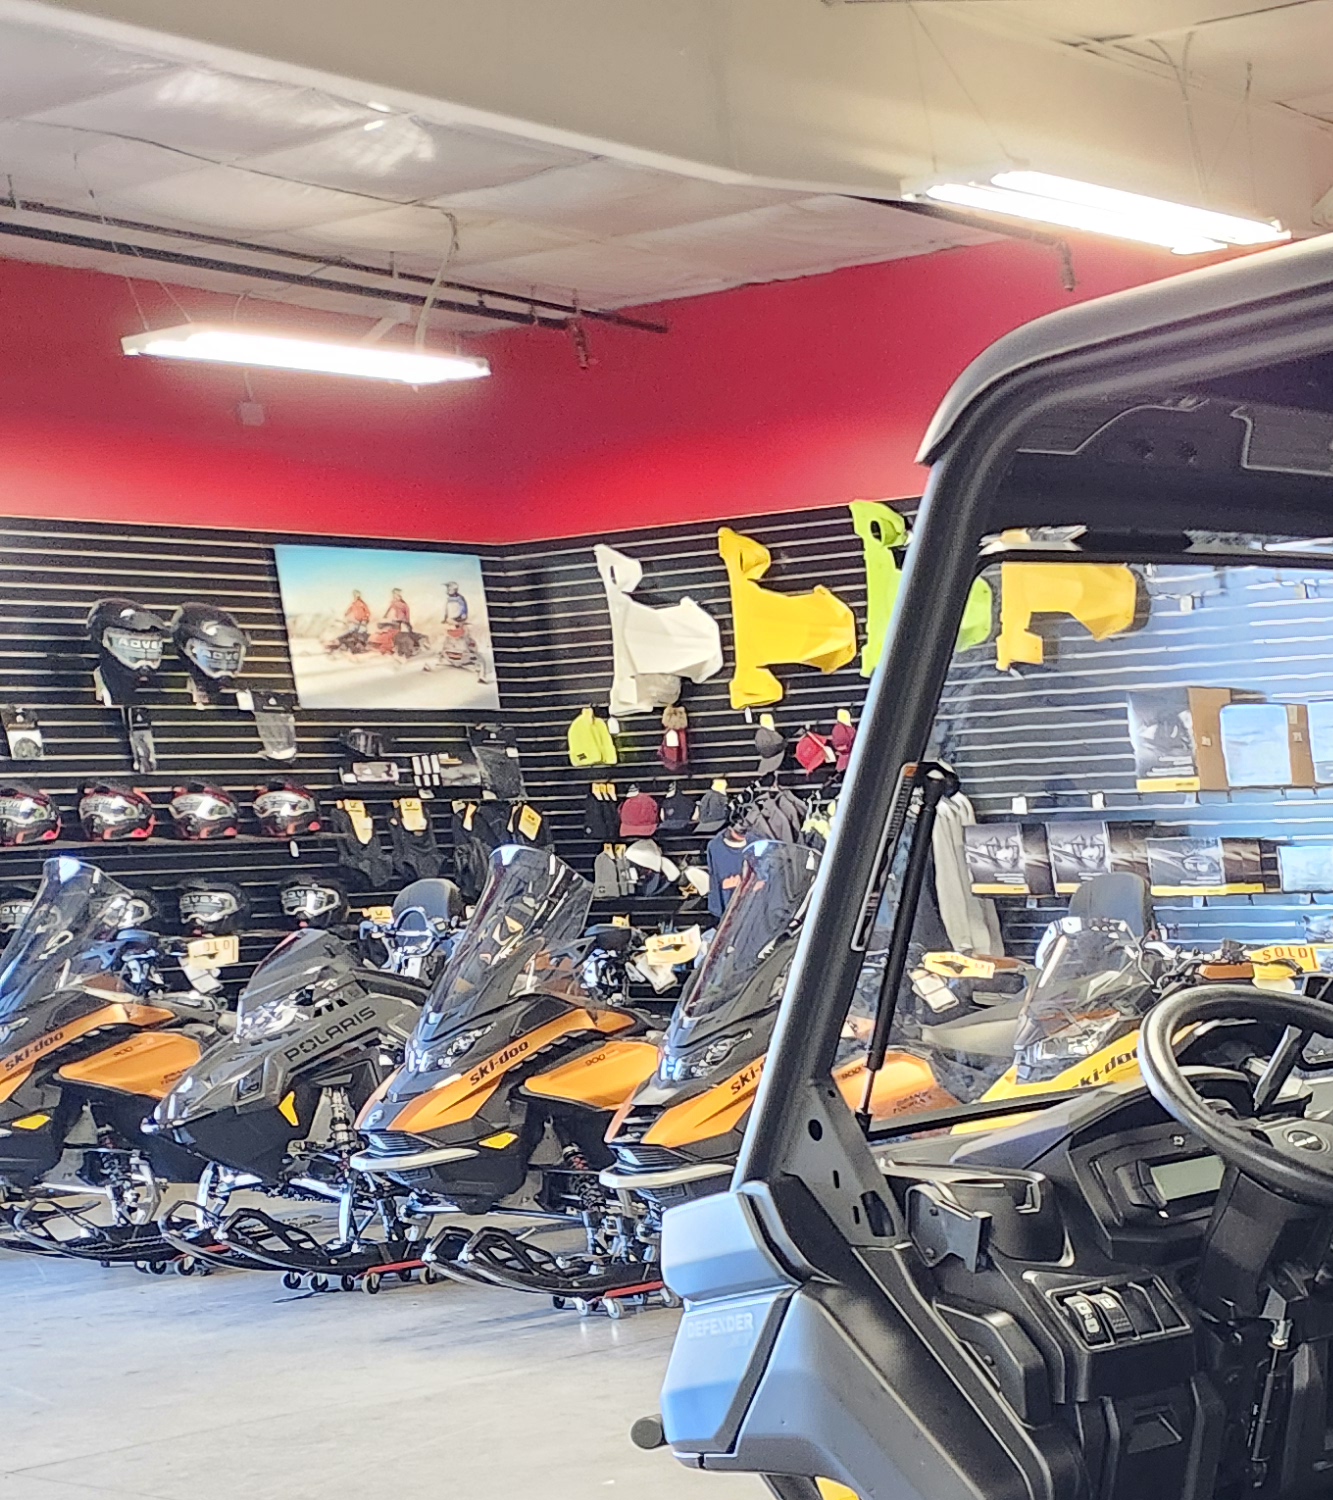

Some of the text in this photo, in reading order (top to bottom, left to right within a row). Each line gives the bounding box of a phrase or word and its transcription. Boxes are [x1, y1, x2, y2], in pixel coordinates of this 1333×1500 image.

[1262, 946, 1308, 961] SOLD
[4, 1030, 65, 1072] ski-doo
[284, 1006, 377, 1062] POLARIS
[469, 1039, 530, 1087] ski-doo
